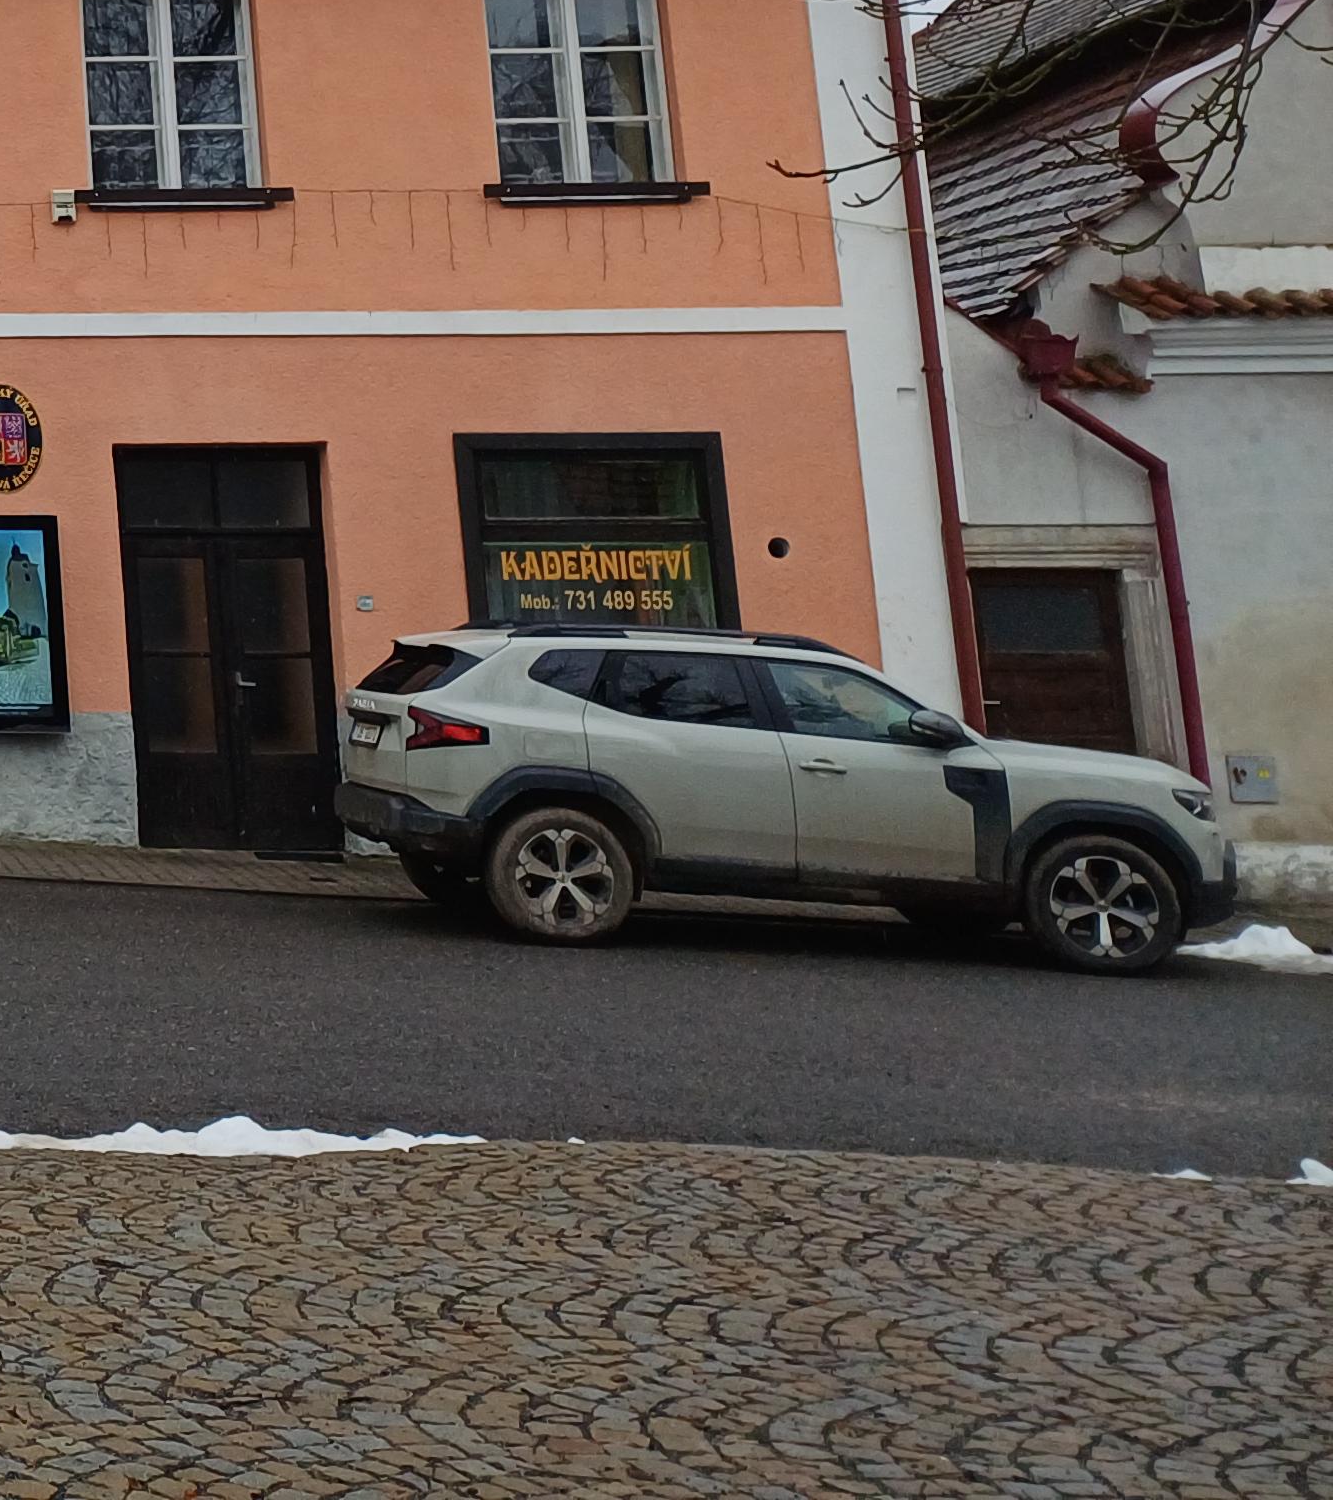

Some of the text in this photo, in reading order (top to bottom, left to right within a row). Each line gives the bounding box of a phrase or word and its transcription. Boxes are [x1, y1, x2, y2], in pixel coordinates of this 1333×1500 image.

[500, 543, 692, 584] KADEŘNICTVÍ
[564, 590, 596, 611] 731
[602, 590, 635, 611] 489
[640, 590, 674, 611] 555
